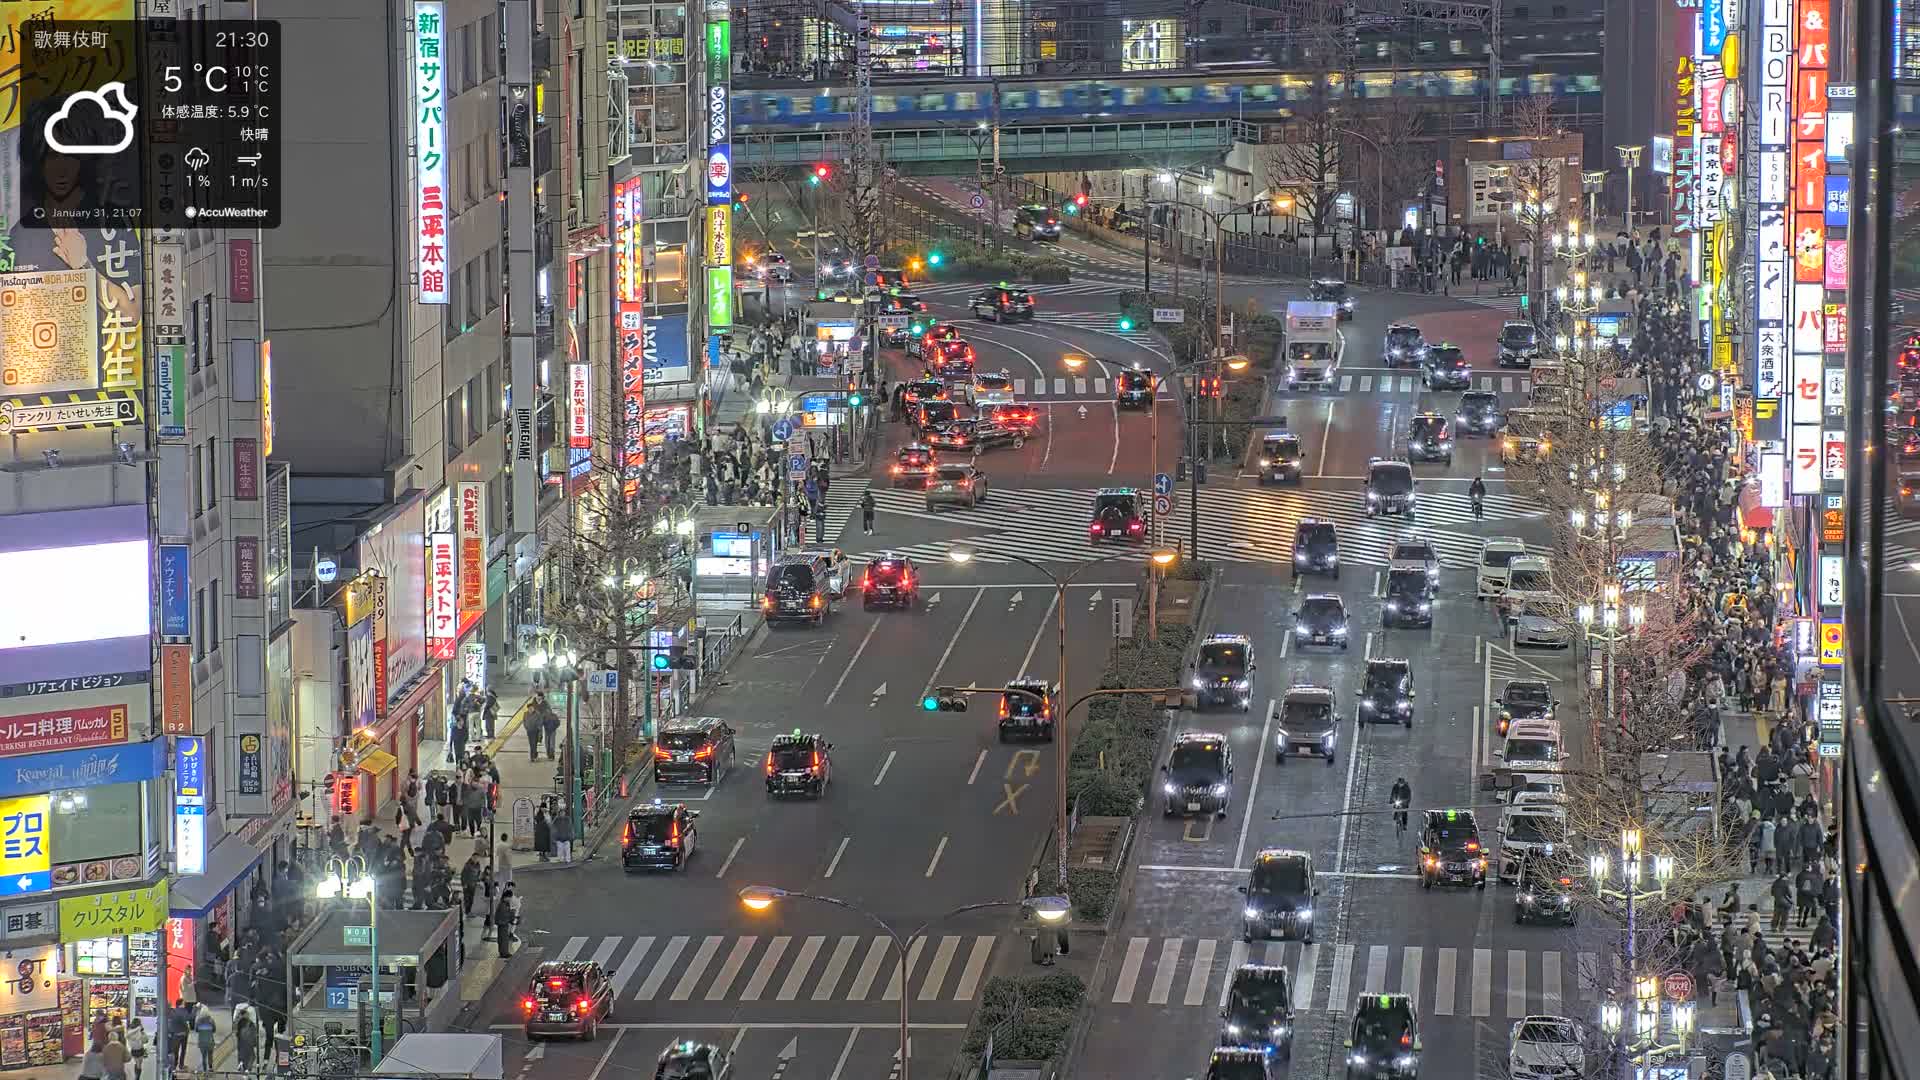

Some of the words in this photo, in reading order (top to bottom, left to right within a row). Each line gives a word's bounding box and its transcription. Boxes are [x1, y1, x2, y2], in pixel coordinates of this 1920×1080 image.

[418, 13, 441, 171] 新宿サンパーク
[1707, 88, 1719, 121] アコム
[711, 162, 726, 178] 薬
[1674, 148, 1696, 233] エスパス
[421, 185, 444, 293] 三平本館
[1, 276, 43, 289] Instagram
[161, 326, 178, 334] 3F
[1761, 331, 1774, 384] 大衆酒場
[160, 355, 173, 416] FamilyMart
[1797, 309, 1822, 470] パセラ
[17, 412, 52, 422] テンクリ
[57, 406, 114, 420] たいせい先生
[1830, 407, 1843, 415] 5F
[518, 409, 530, 460] HOMEGAME
[464, 488, 474, 532] GAME
[1829, 499, 1840, 507] 3F
[435, 543, 452, 630] 三平ストア
[113, 712, 122, 736] 5F
[168, 723, 184, 731] B2
[29, 736, 73, 748] RESTAURANT
[3, 812, 42, 836] プロ
[4, 836, 43, 859] ミス
[73, 904, 145, 928] クリスタル
[330, 992, 345, 1005] 12
